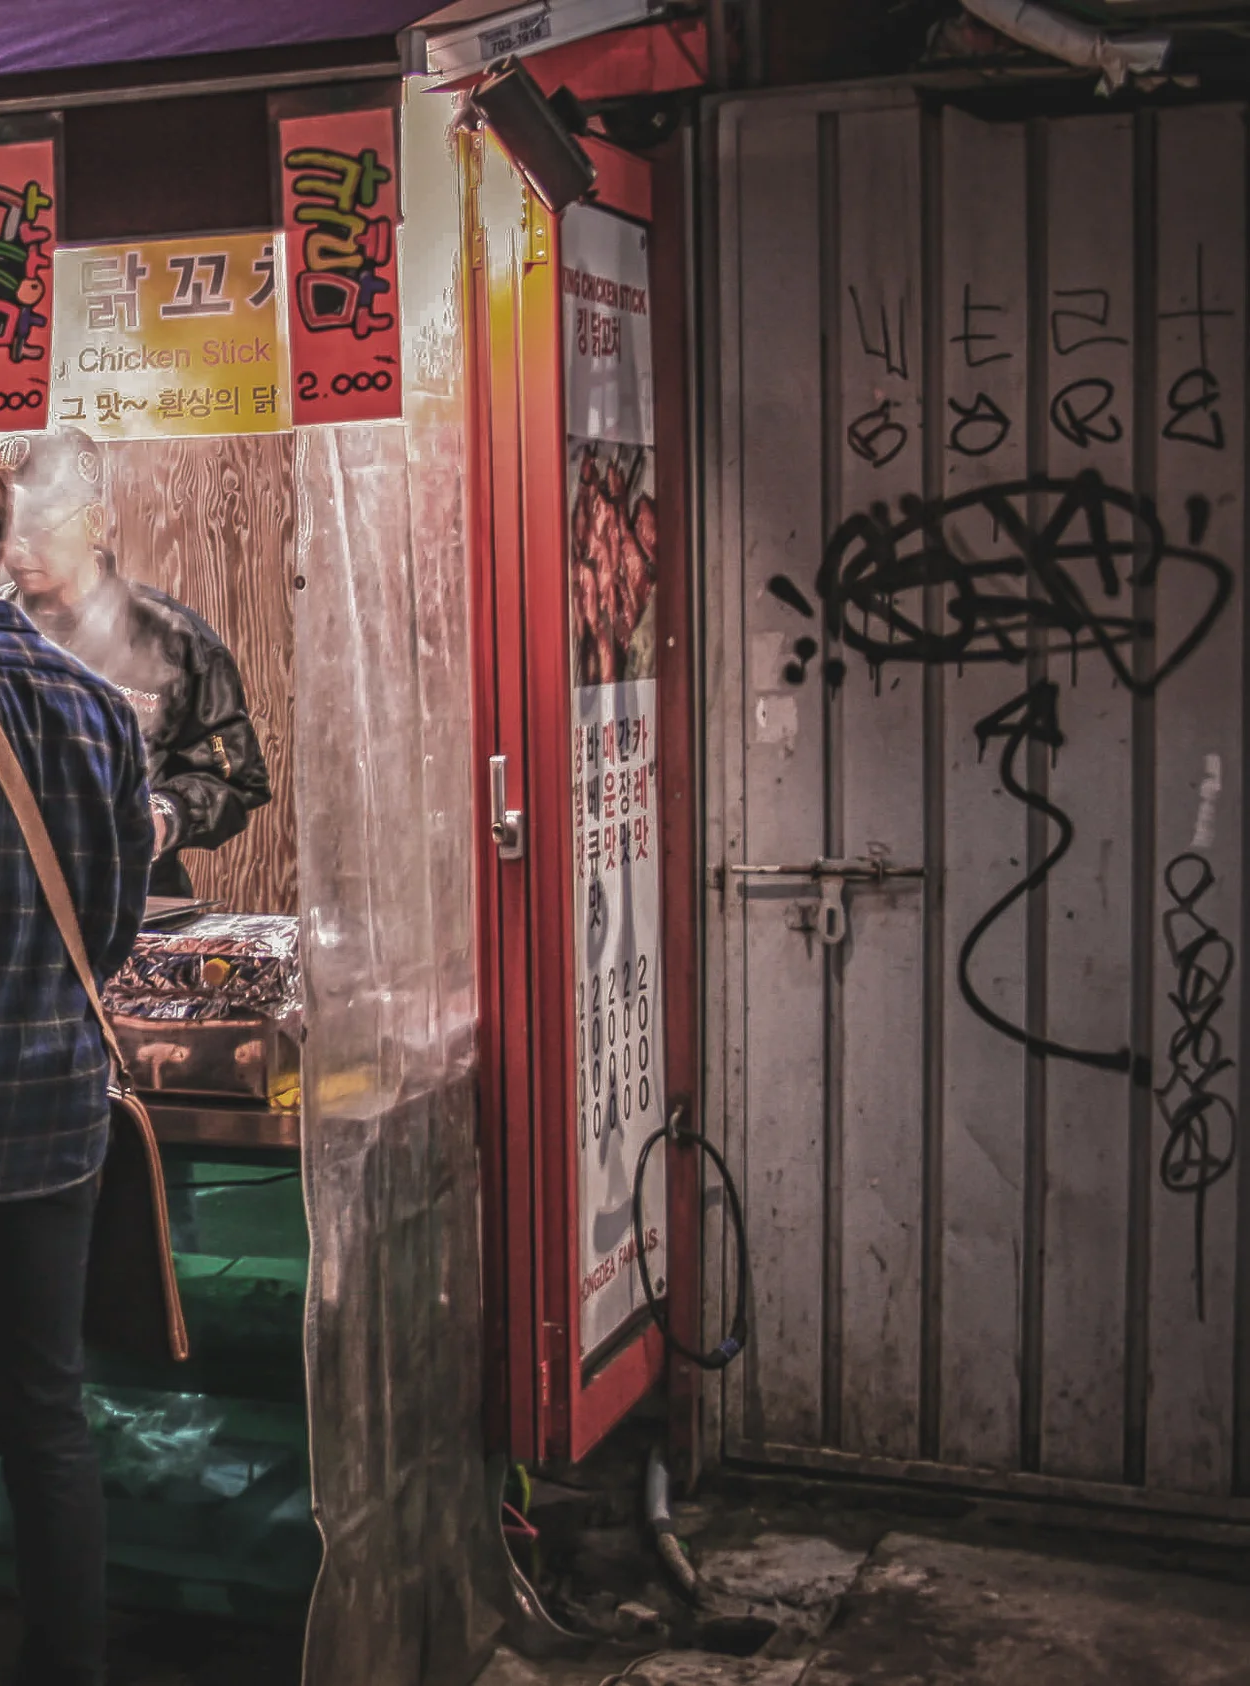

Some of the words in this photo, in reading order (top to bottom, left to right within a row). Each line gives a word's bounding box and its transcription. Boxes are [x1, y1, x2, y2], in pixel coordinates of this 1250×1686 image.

[78, 346, 191, 373] Chicken
[202, 337, 271, 367] Stick
[619, 284, 647, 315] STICK
[59, 397, 86, 420] 그
[158, 386, 239, 419] 환상의
[586, 722, 601, 930] 바베큐맛
[602, 719, 616, 871] 매운맛
[618, 716, 631, 866] 간장맛
[632, 714, 648, 861] 카레맛
[592, 974, 601, 1140] 2000
[608, 967, 617, 1130] 2000
[622, 960, 631, 1121] 2000
[637, 954, 650, 1112] 2000
